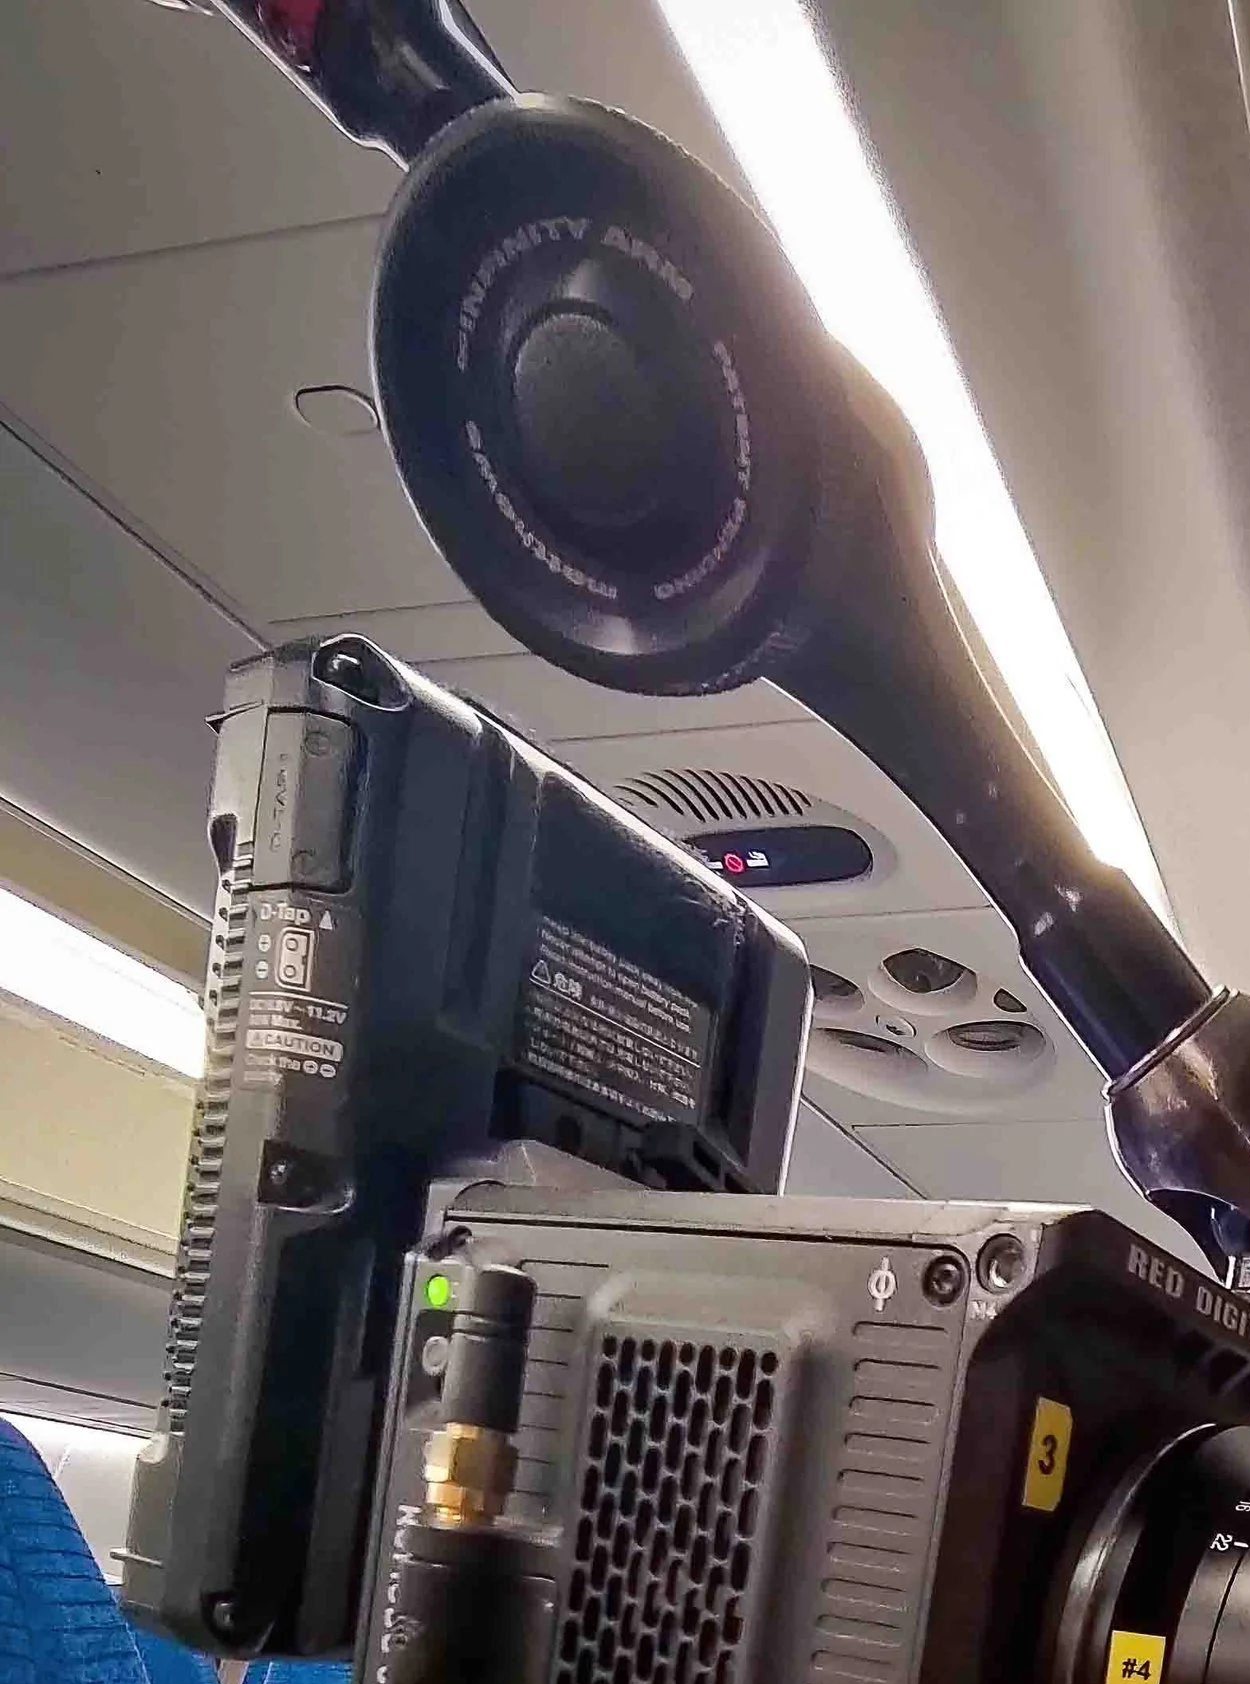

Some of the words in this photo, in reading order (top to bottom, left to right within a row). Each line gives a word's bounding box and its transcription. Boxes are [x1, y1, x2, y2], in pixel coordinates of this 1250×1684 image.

[266, 1033, 335, 1056] CAUTION
[1127, 1243, 1186, 1299] RED
[1037, 1434, 1058, 1476] 3
[1210, 1533, 1233, 1551] 22
[1121, 1657, 1151, 1681] #4
